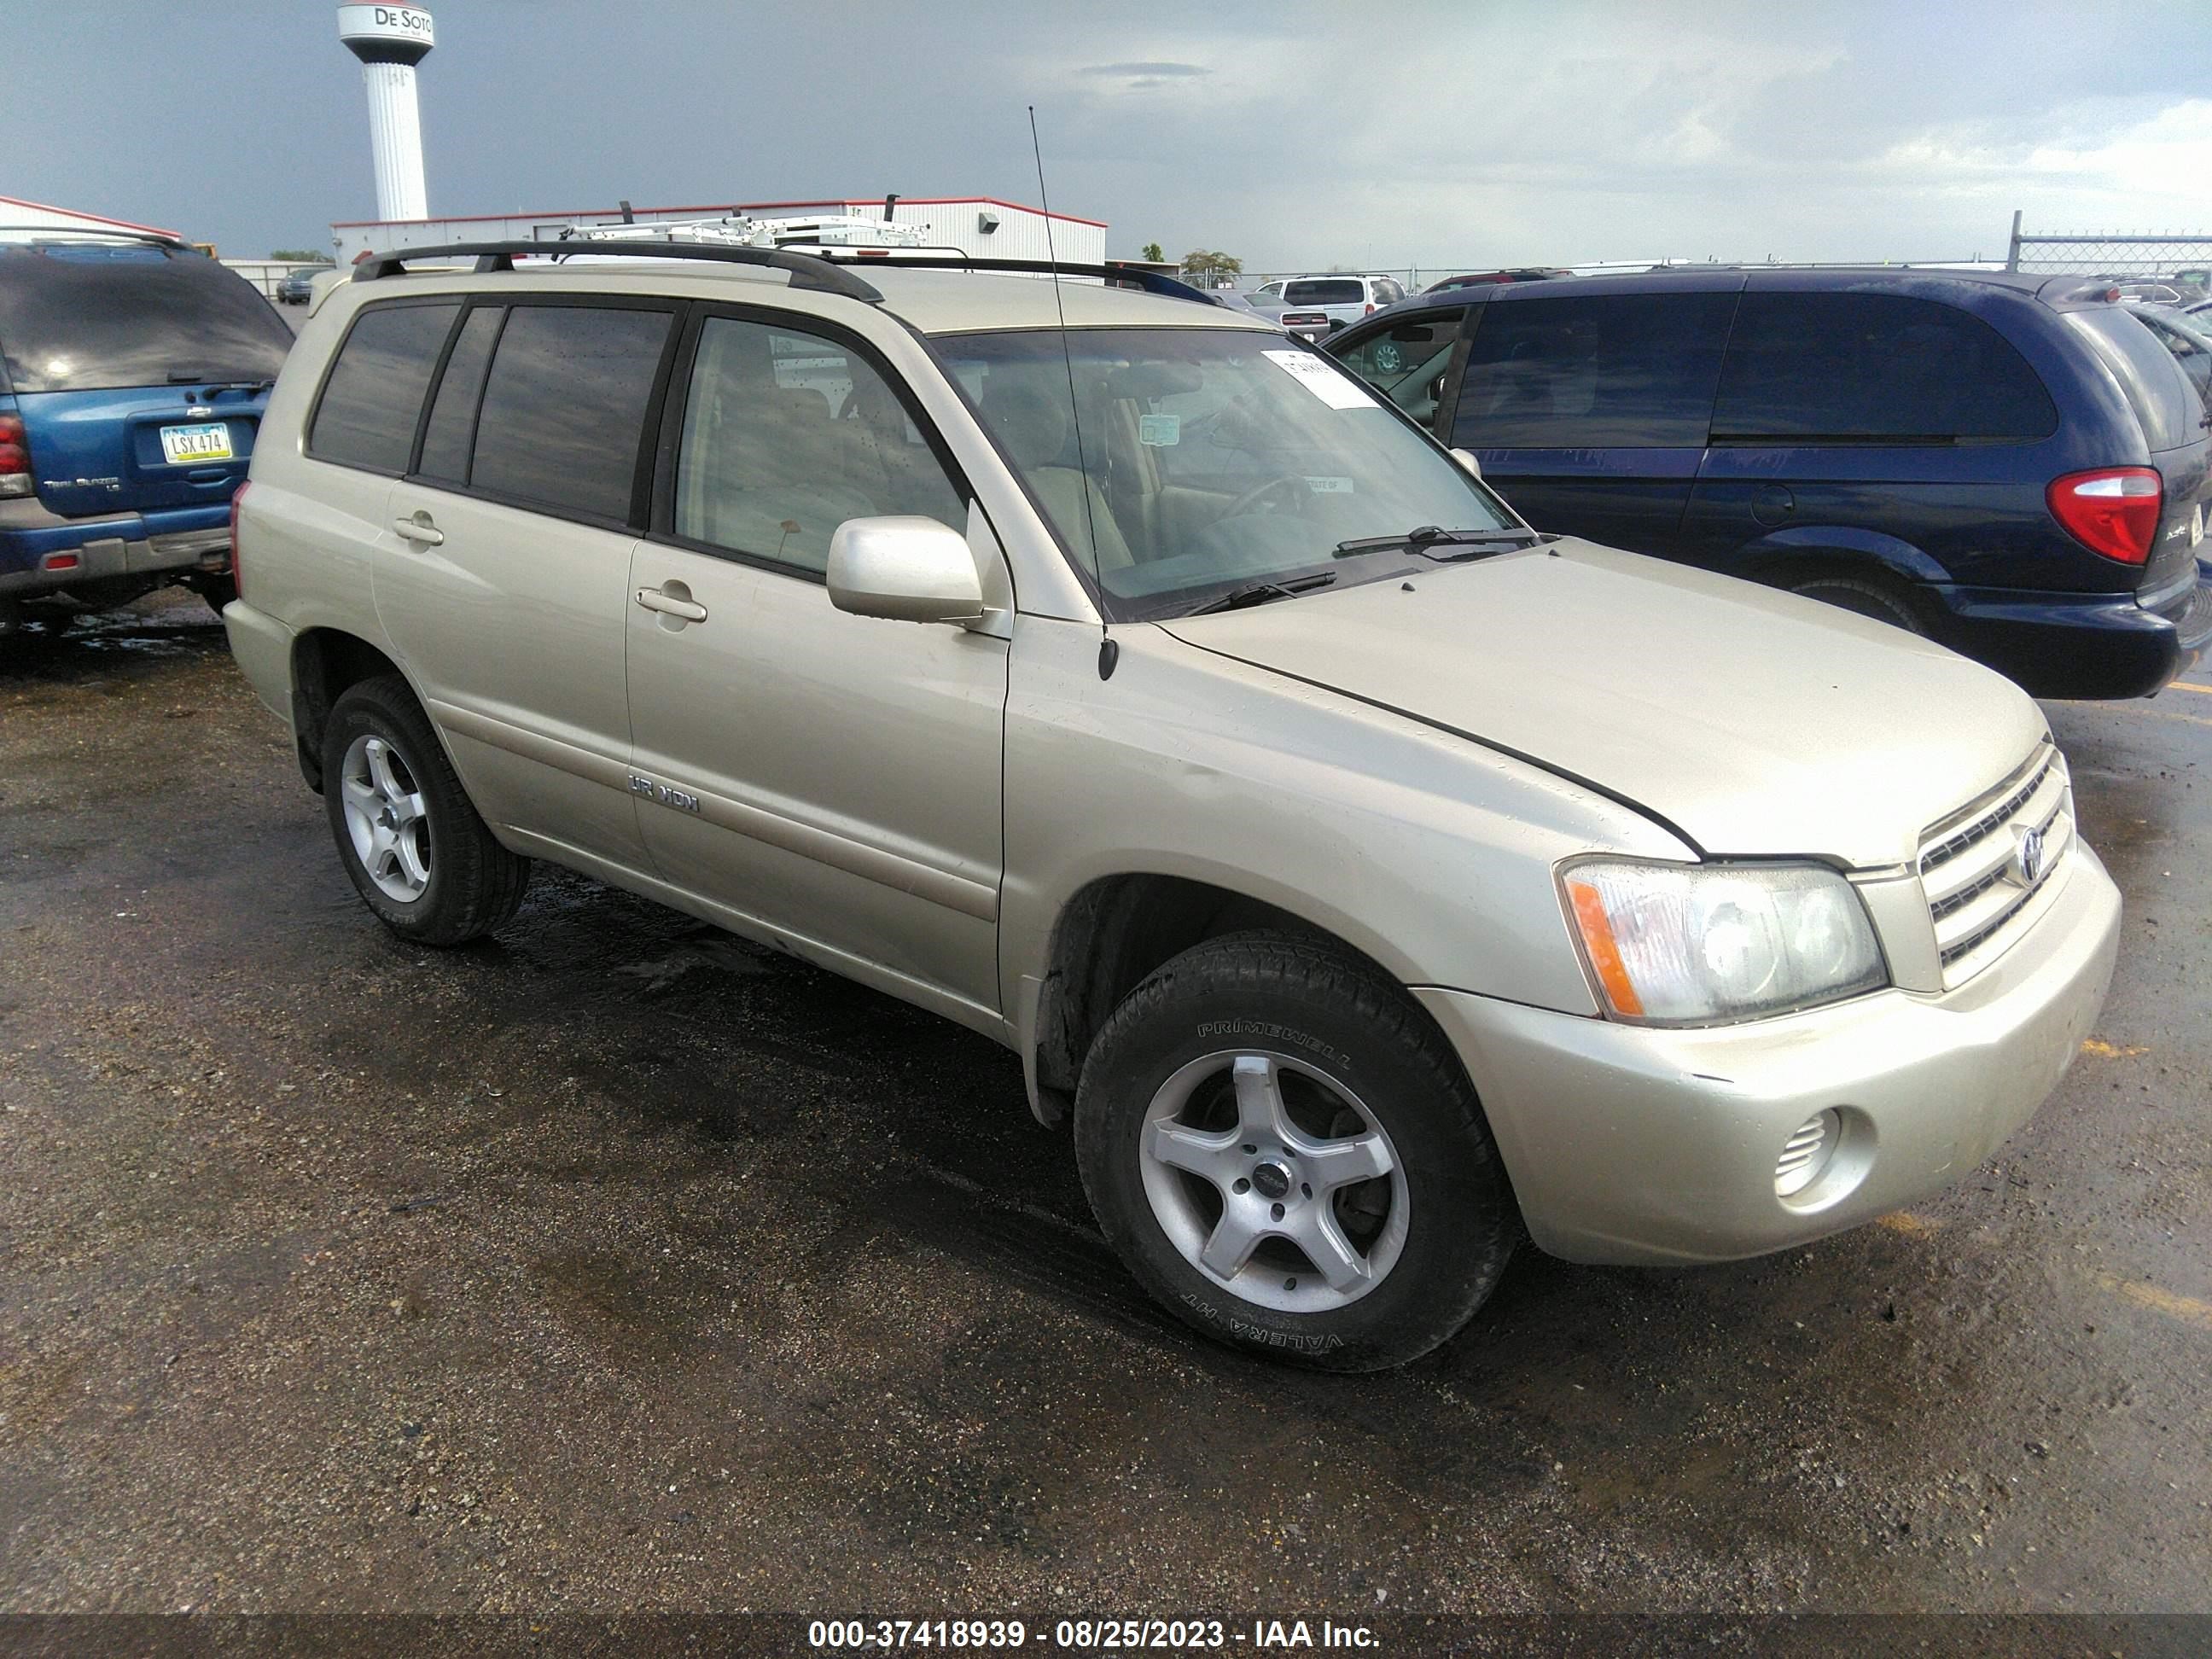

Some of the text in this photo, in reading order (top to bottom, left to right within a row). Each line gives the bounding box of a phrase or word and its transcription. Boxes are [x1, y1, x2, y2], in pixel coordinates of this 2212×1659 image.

[172, 434, 222, 454] LSX 474
[1180, 1293, 1344, 1351] VALERA HT
